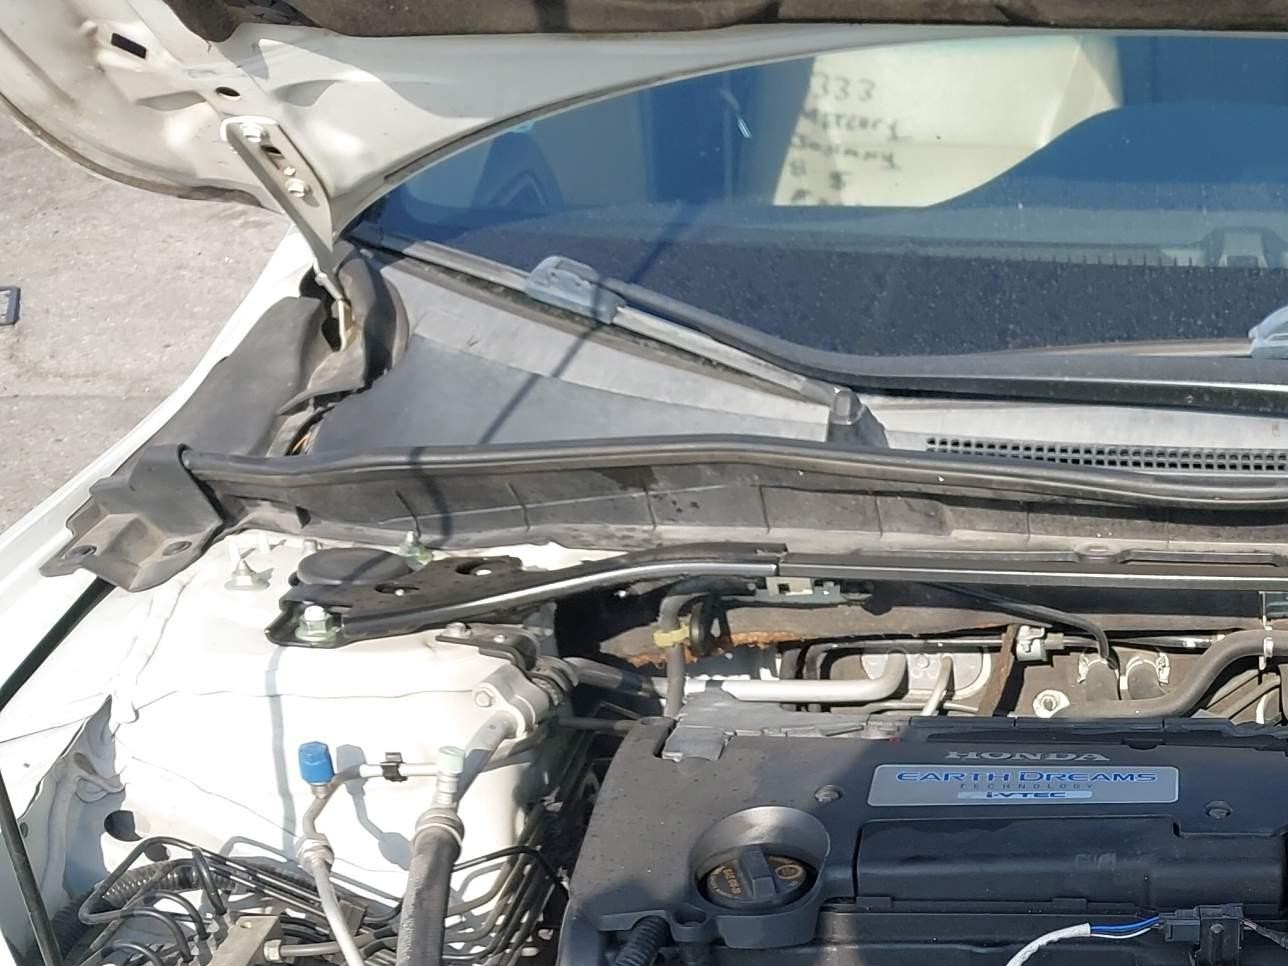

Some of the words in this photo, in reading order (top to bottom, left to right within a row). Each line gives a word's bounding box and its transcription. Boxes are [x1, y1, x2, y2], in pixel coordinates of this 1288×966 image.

[944, 751, 1110, 761] HONDA
[897, 771, 1010, 782] EARTH
[1019, 771, 1157, 782] DREAMS
